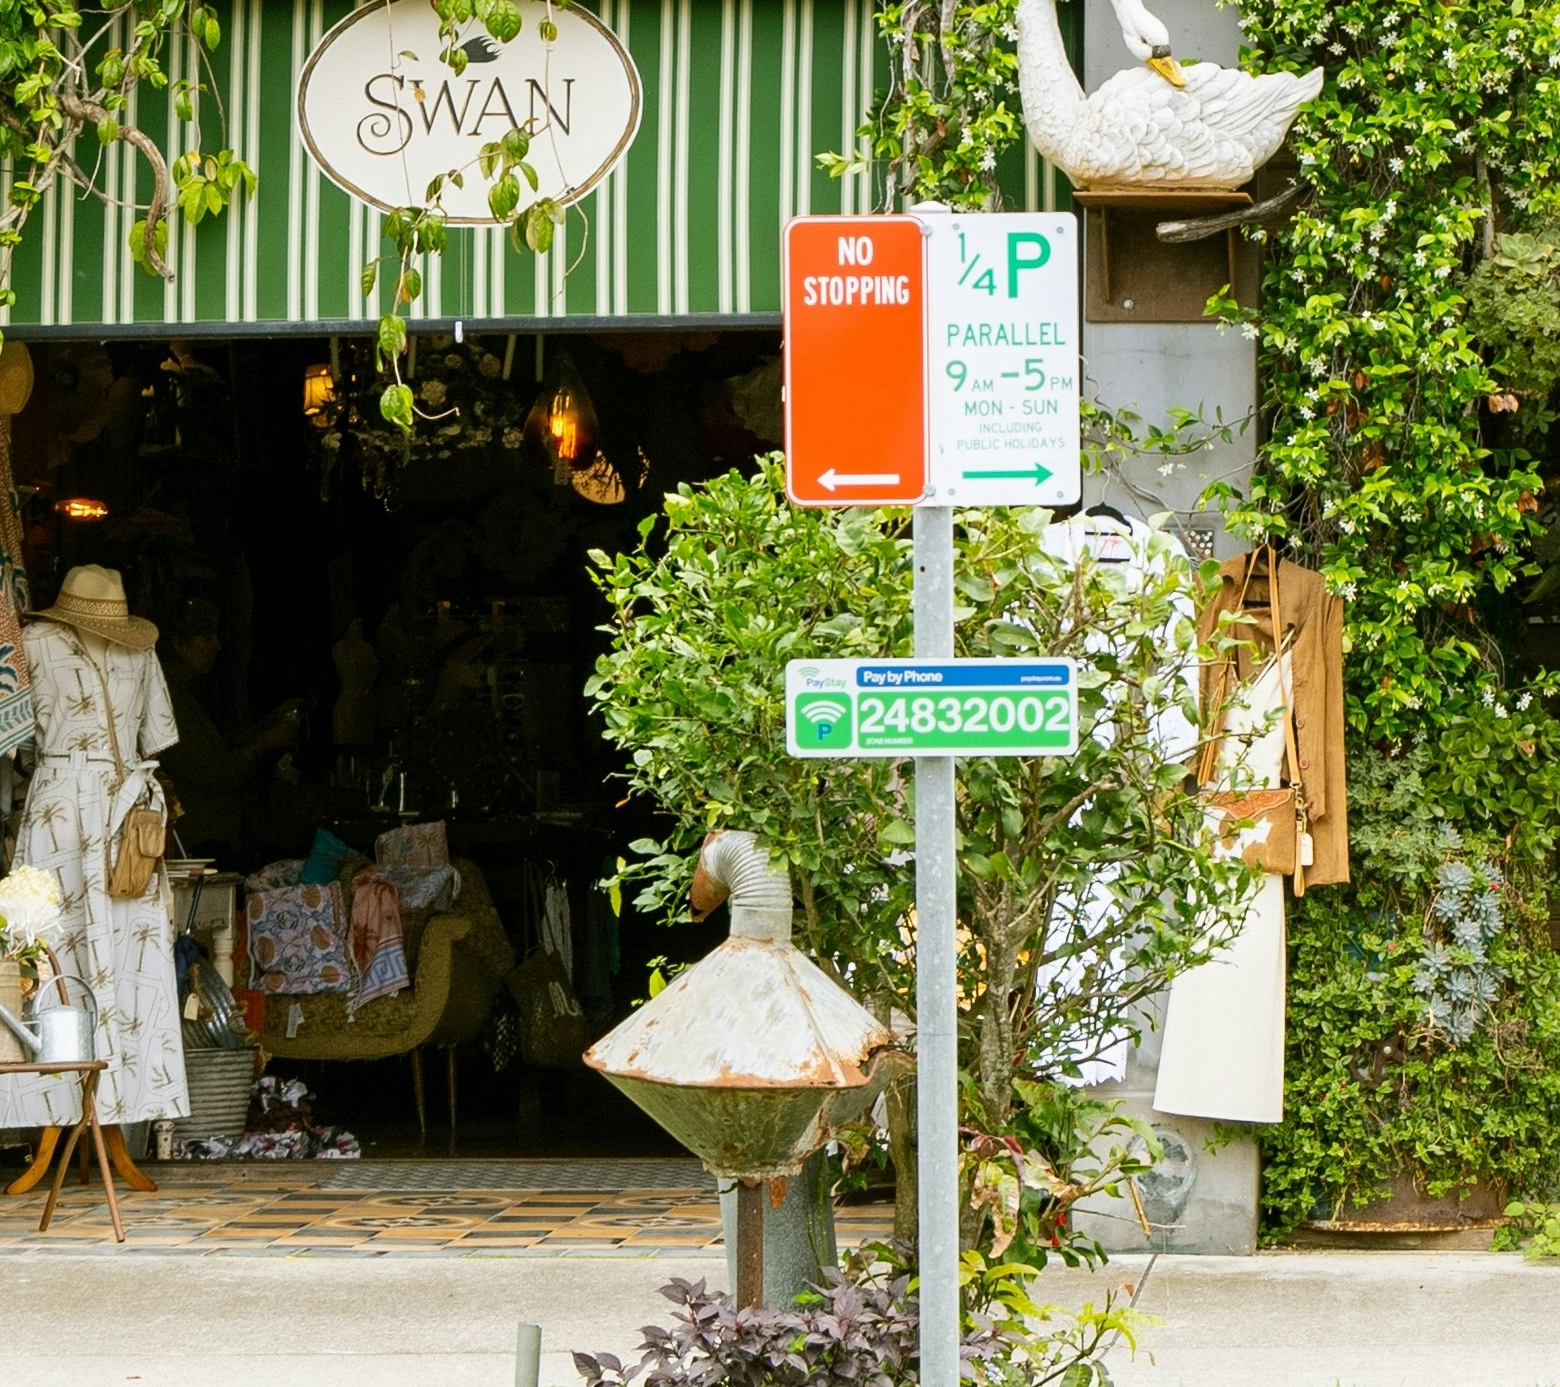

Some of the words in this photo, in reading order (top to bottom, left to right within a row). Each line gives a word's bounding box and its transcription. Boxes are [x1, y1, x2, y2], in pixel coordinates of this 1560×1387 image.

[356, 73, 576, 156] SWAN
[838, 236, 874, 266] NO
[803, 275, 910, 306] STOPPING
[947, 322, 1067, 347] PARALLEL
[964, 399, 1003, 417] MON
[1022, 398, 1058, 416] SUN
[978, 421, 1042, 434] INCLUDING
[956, 438, 1000, 451] PUBLIC
[1003, 436, 1066, 450] HOLIDAYS
[806, 677, 847, 689] PayStay
[863, 669, 888, 686] Pay
[887, 669, 903, 685] by
[903, 669, 944, 683] Phone
[859, 696, 1071, 734] 24832002
